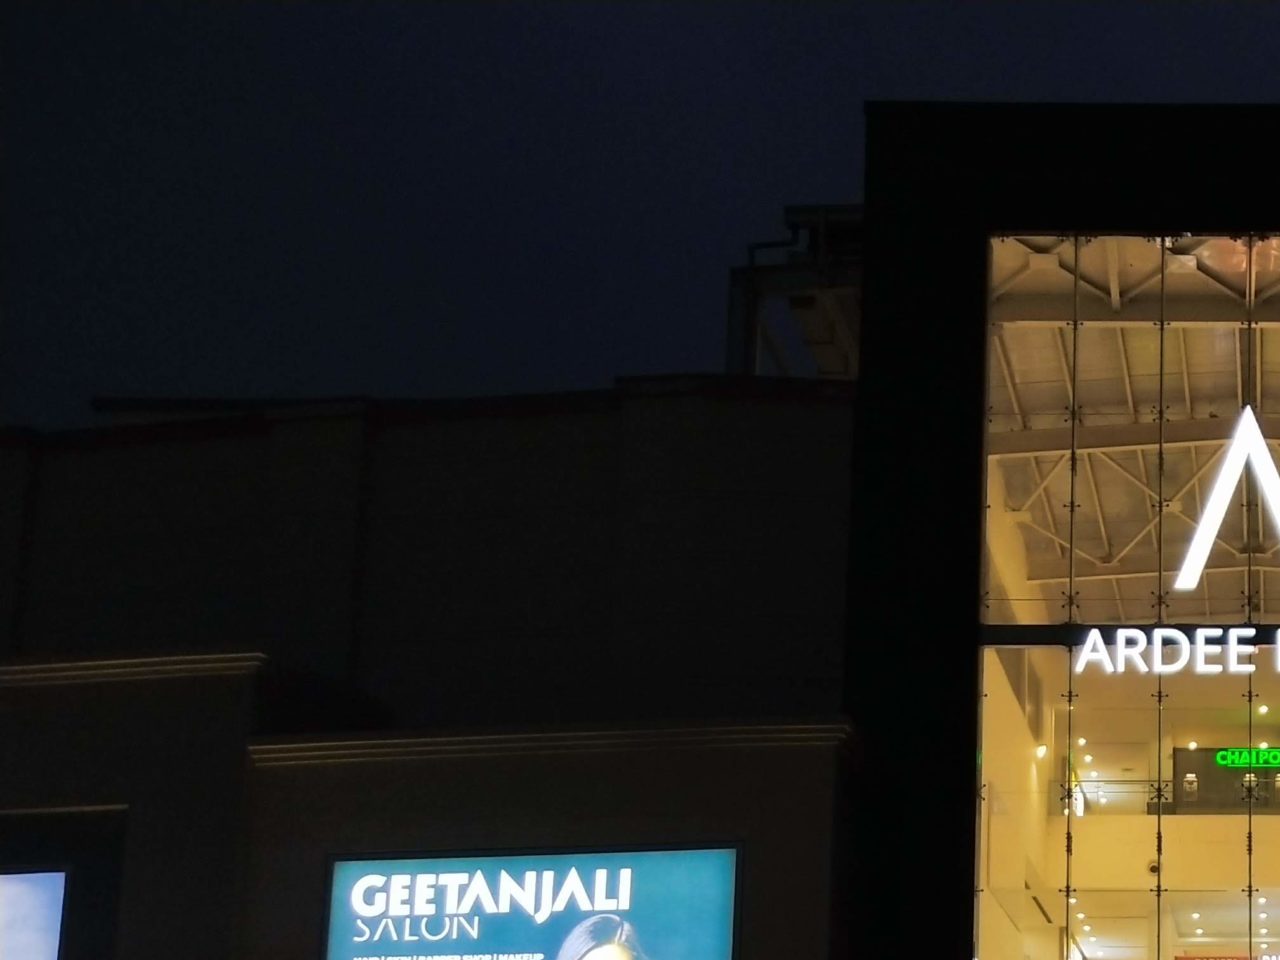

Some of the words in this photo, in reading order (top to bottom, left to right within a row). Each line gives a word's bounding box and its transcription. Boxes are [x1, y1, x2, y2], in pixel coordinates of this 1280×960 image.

[1075, 628, 1256, 673] ARDEE
[1216, 750, 1257, 765] CHAI
[351, 868, 632, 924] GEETANJALI
[353, 916, 478, 942] SALON
